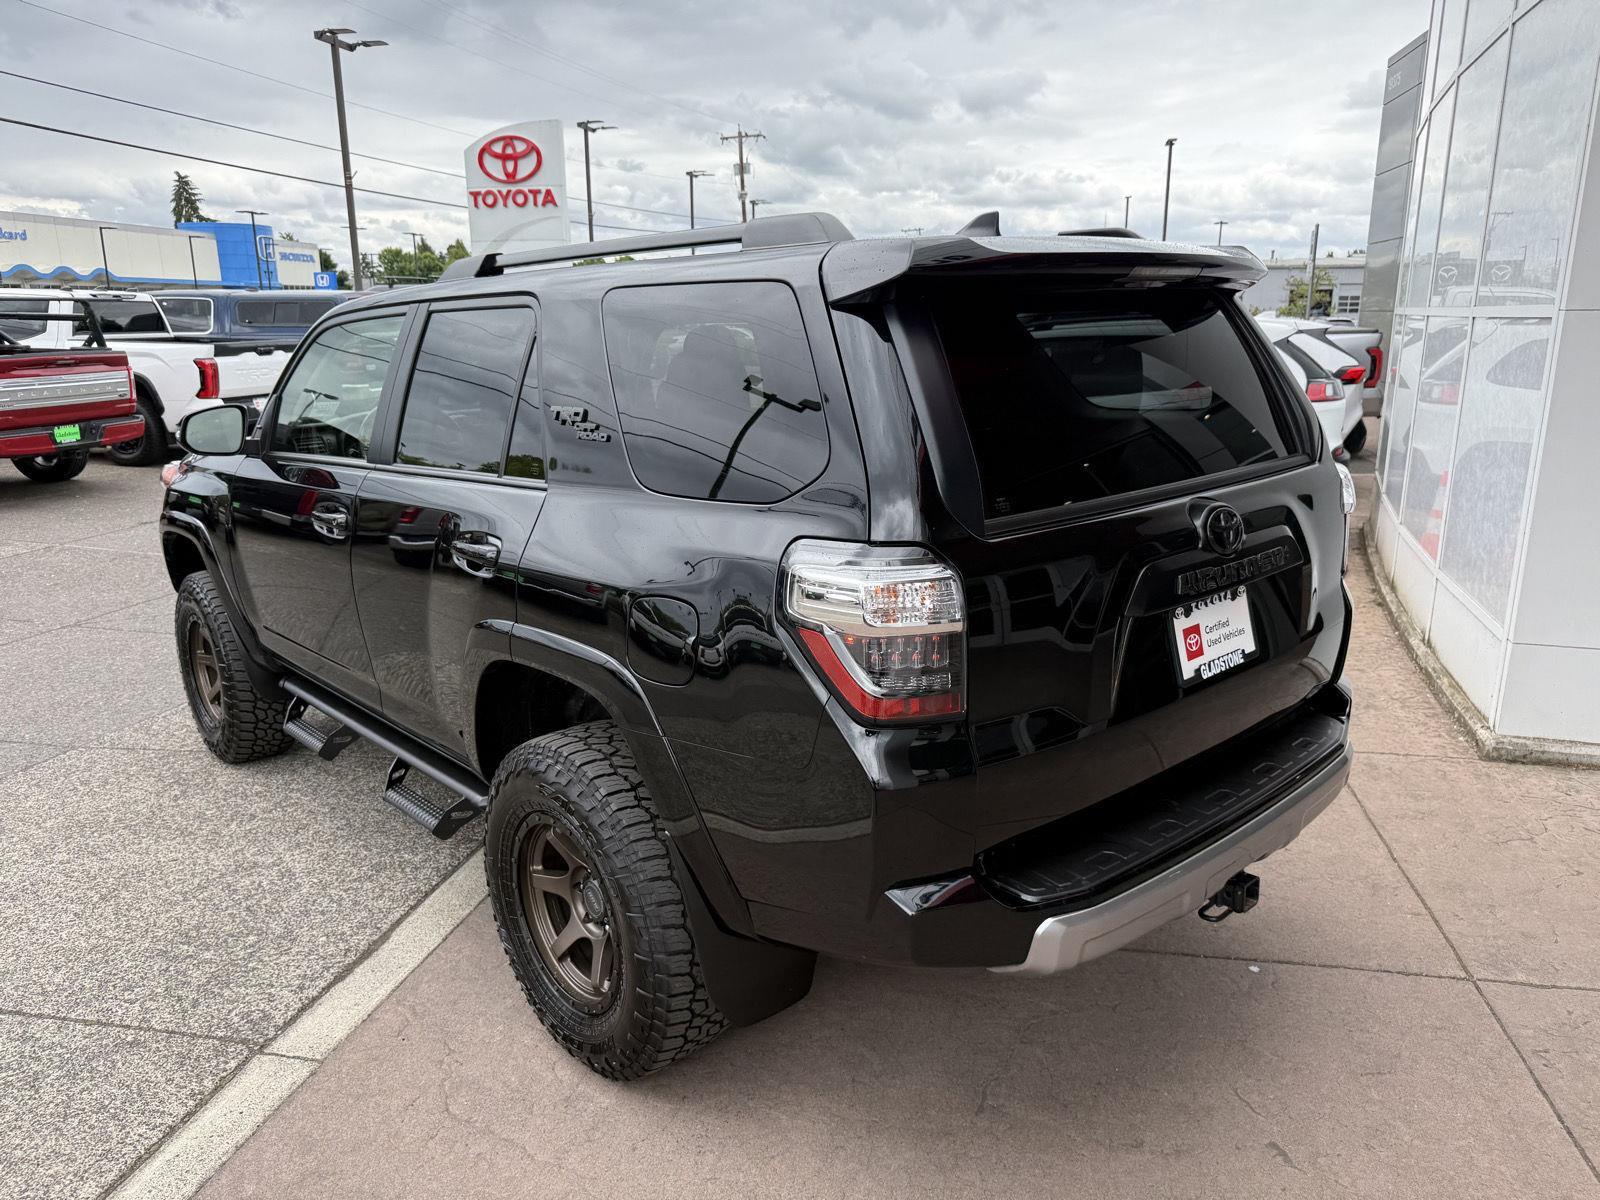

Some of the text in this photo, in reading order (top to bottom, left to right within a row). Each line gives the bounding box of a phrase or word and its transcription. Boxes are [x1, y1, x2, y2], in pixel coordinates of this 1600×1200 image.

[468, 188, 559, 209] TOYOTA
[279, 252, 316, 264] HONDA
[1190, 589, 1232, 613] TOYOTA
[1204, 617, 1231, 635] Certified
[1206, 626, 1246, 648] Used Vehicles
[1200, 649, 1245, 680] GLADSTONE
